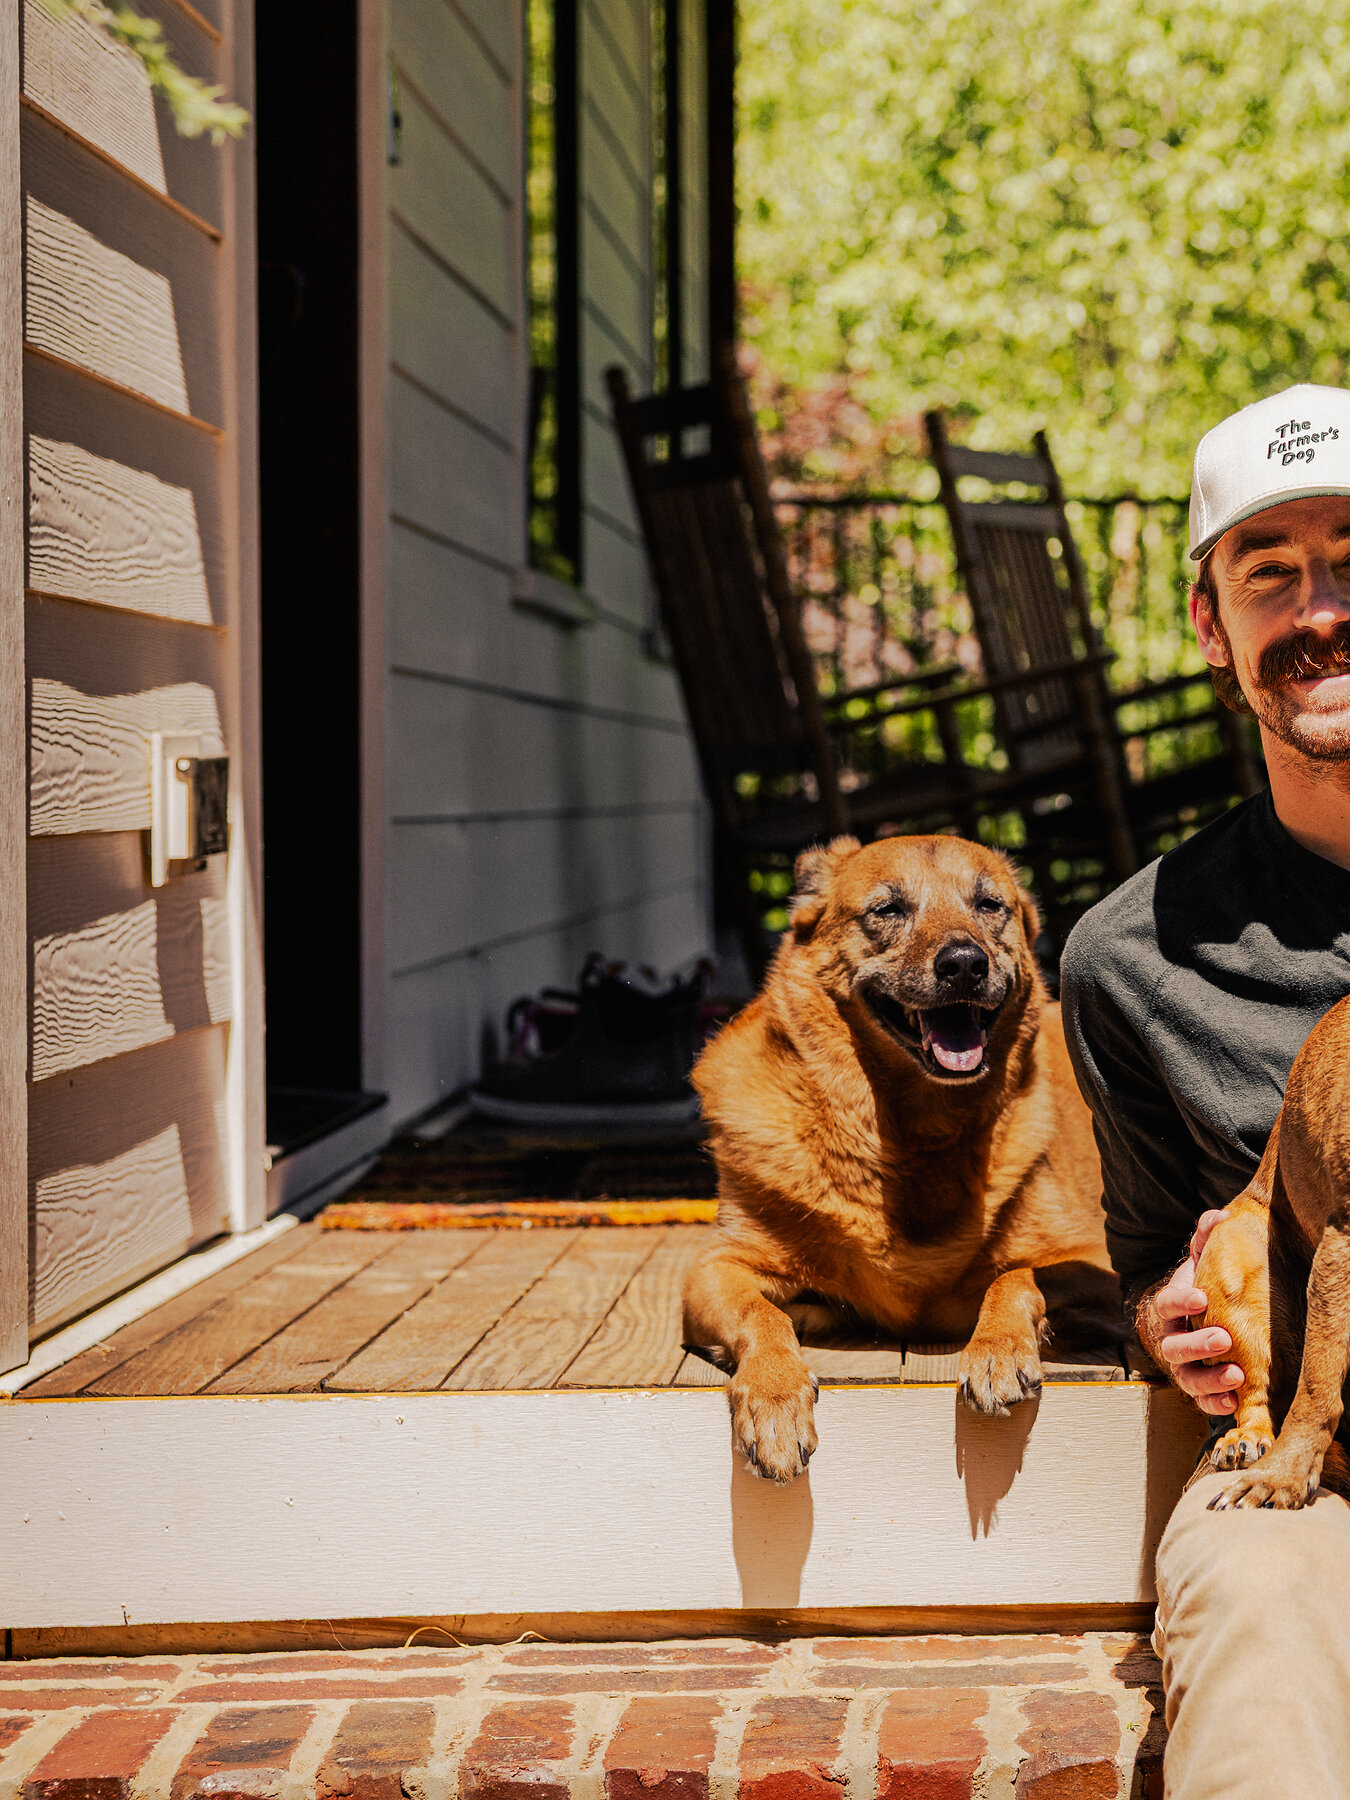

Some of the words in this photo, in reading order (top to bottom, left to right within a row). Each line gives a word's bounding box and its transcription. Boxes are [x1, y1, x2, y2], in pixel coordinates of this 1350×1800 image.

[1275, 419, 1311, 438] The
[1267, 426, 1339, 459] Farmer's
[1281, 448, 1315, 466] Dog
